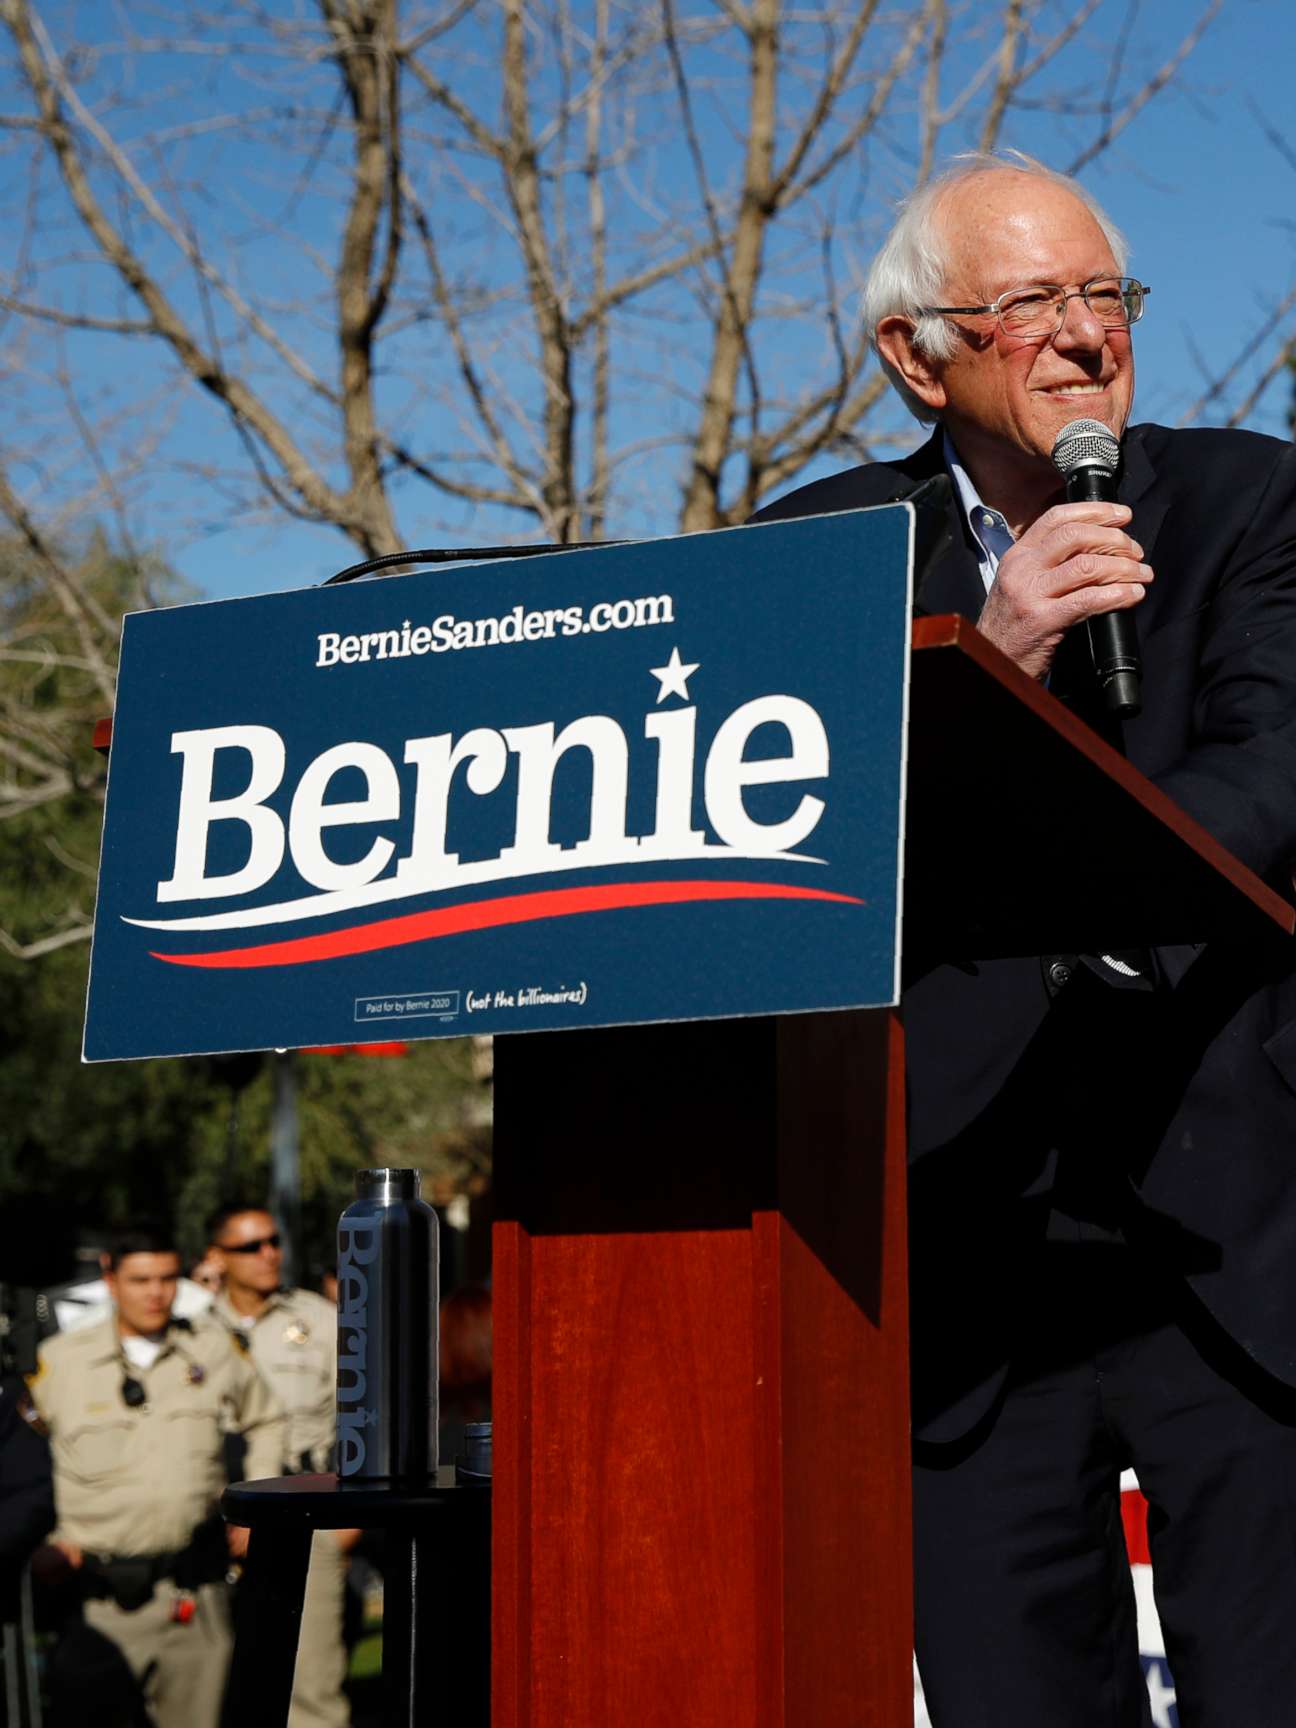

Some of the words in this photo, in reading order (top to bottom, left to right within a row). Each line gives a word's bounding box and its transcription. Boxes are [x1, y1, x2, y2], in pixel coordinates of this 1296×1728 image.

[315, 594, 675, 668] BernieSanders.com
[157, 647, 829, 904] Bernie
[366, 1002, 382, 1013] Paid
[383, 1001, 394, 1012] for
[395, 1000, 405, 1013] by
[406, 999, 430, 1011] Bernie
[431, 998, 450, 1009] 2020
[466, 989, 491, 1013] (not
[494, 990, 515, 1009] the
[517, 981, 588, 1007] billionaires)
[337, 1212, 382, 1477] Bernie
